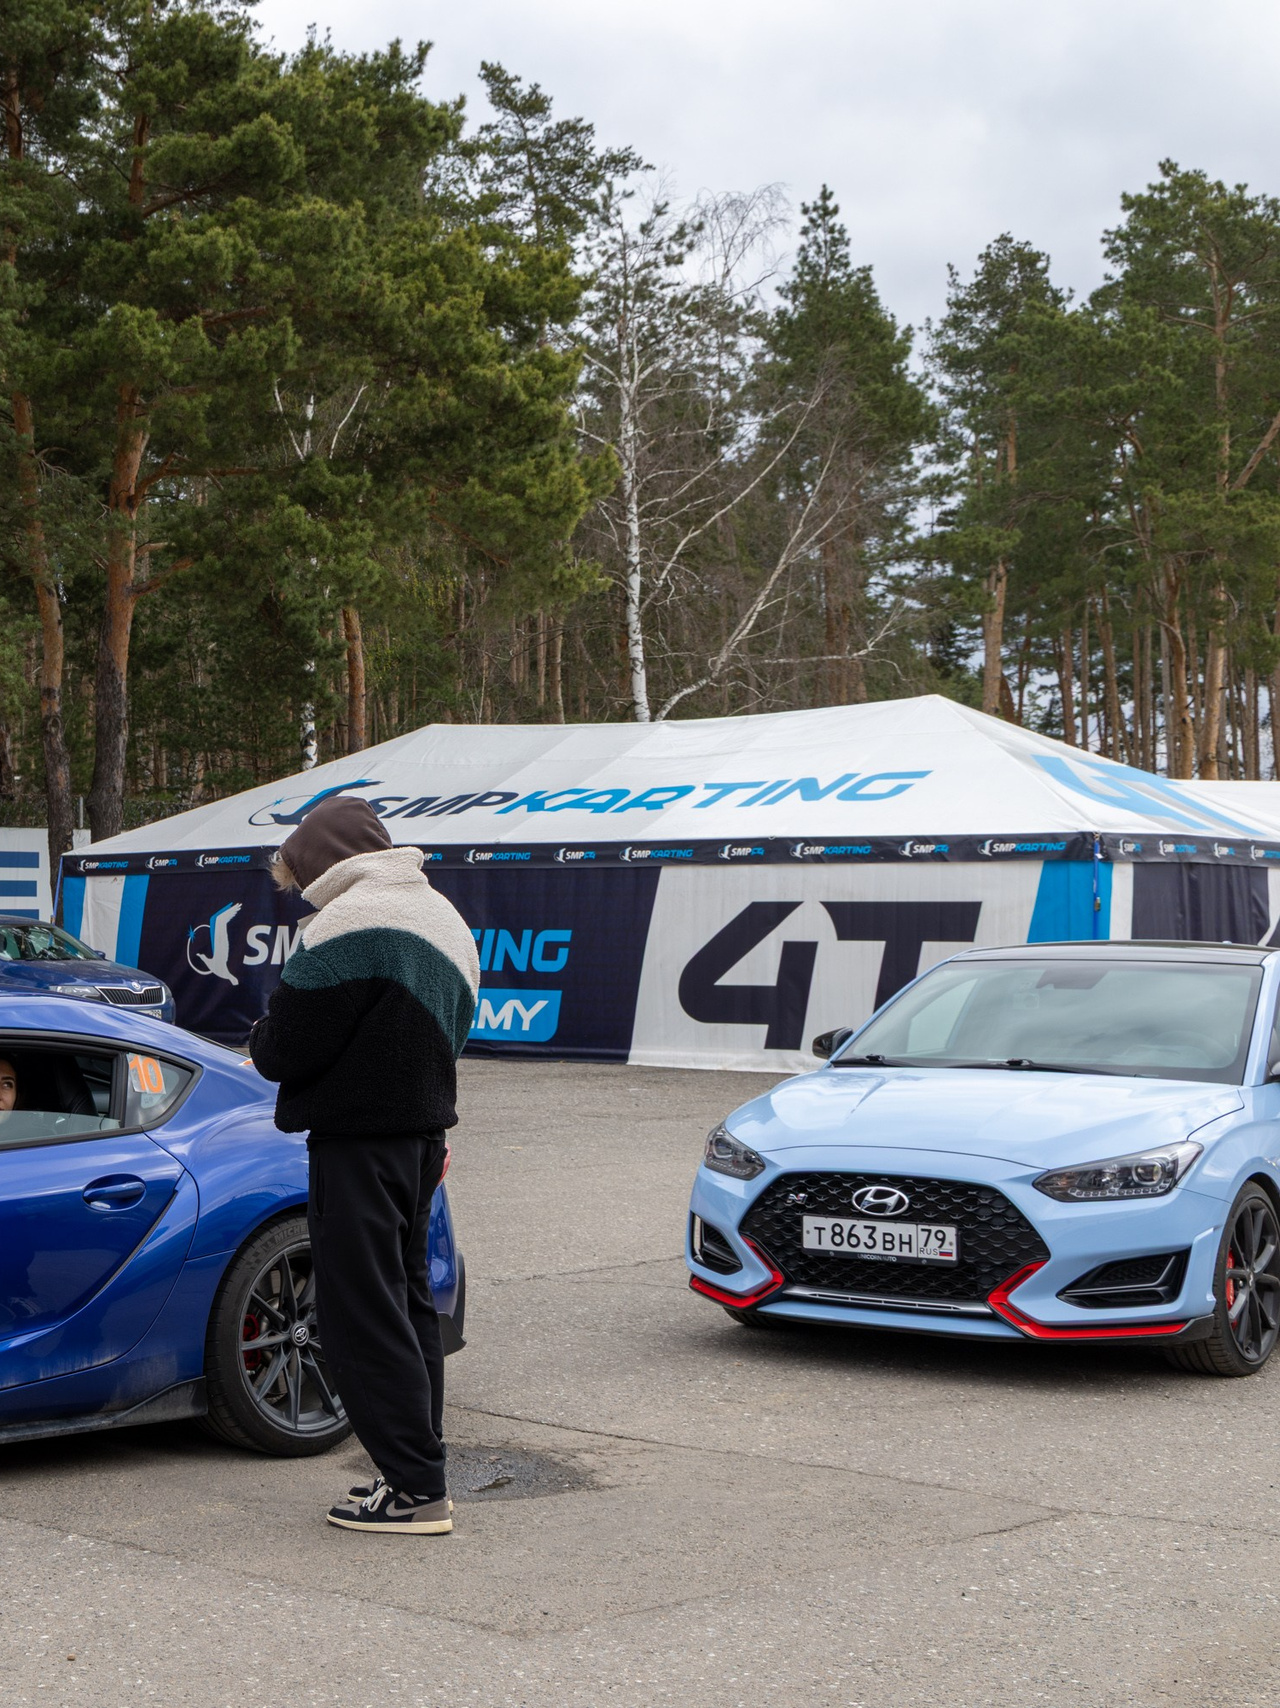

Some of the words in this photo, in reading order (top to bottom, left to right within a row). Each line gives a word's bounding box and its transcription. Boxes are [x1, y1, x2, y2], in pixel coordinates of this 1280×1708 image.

[678, 901, 982, 1050] 4T
[129, 1054, 163, 1093] 10
[274, 1224, 308, 1243] MICHE
[920, 1228, 946, 1249] 79
[919, 1247, 938, 1256] RUS
